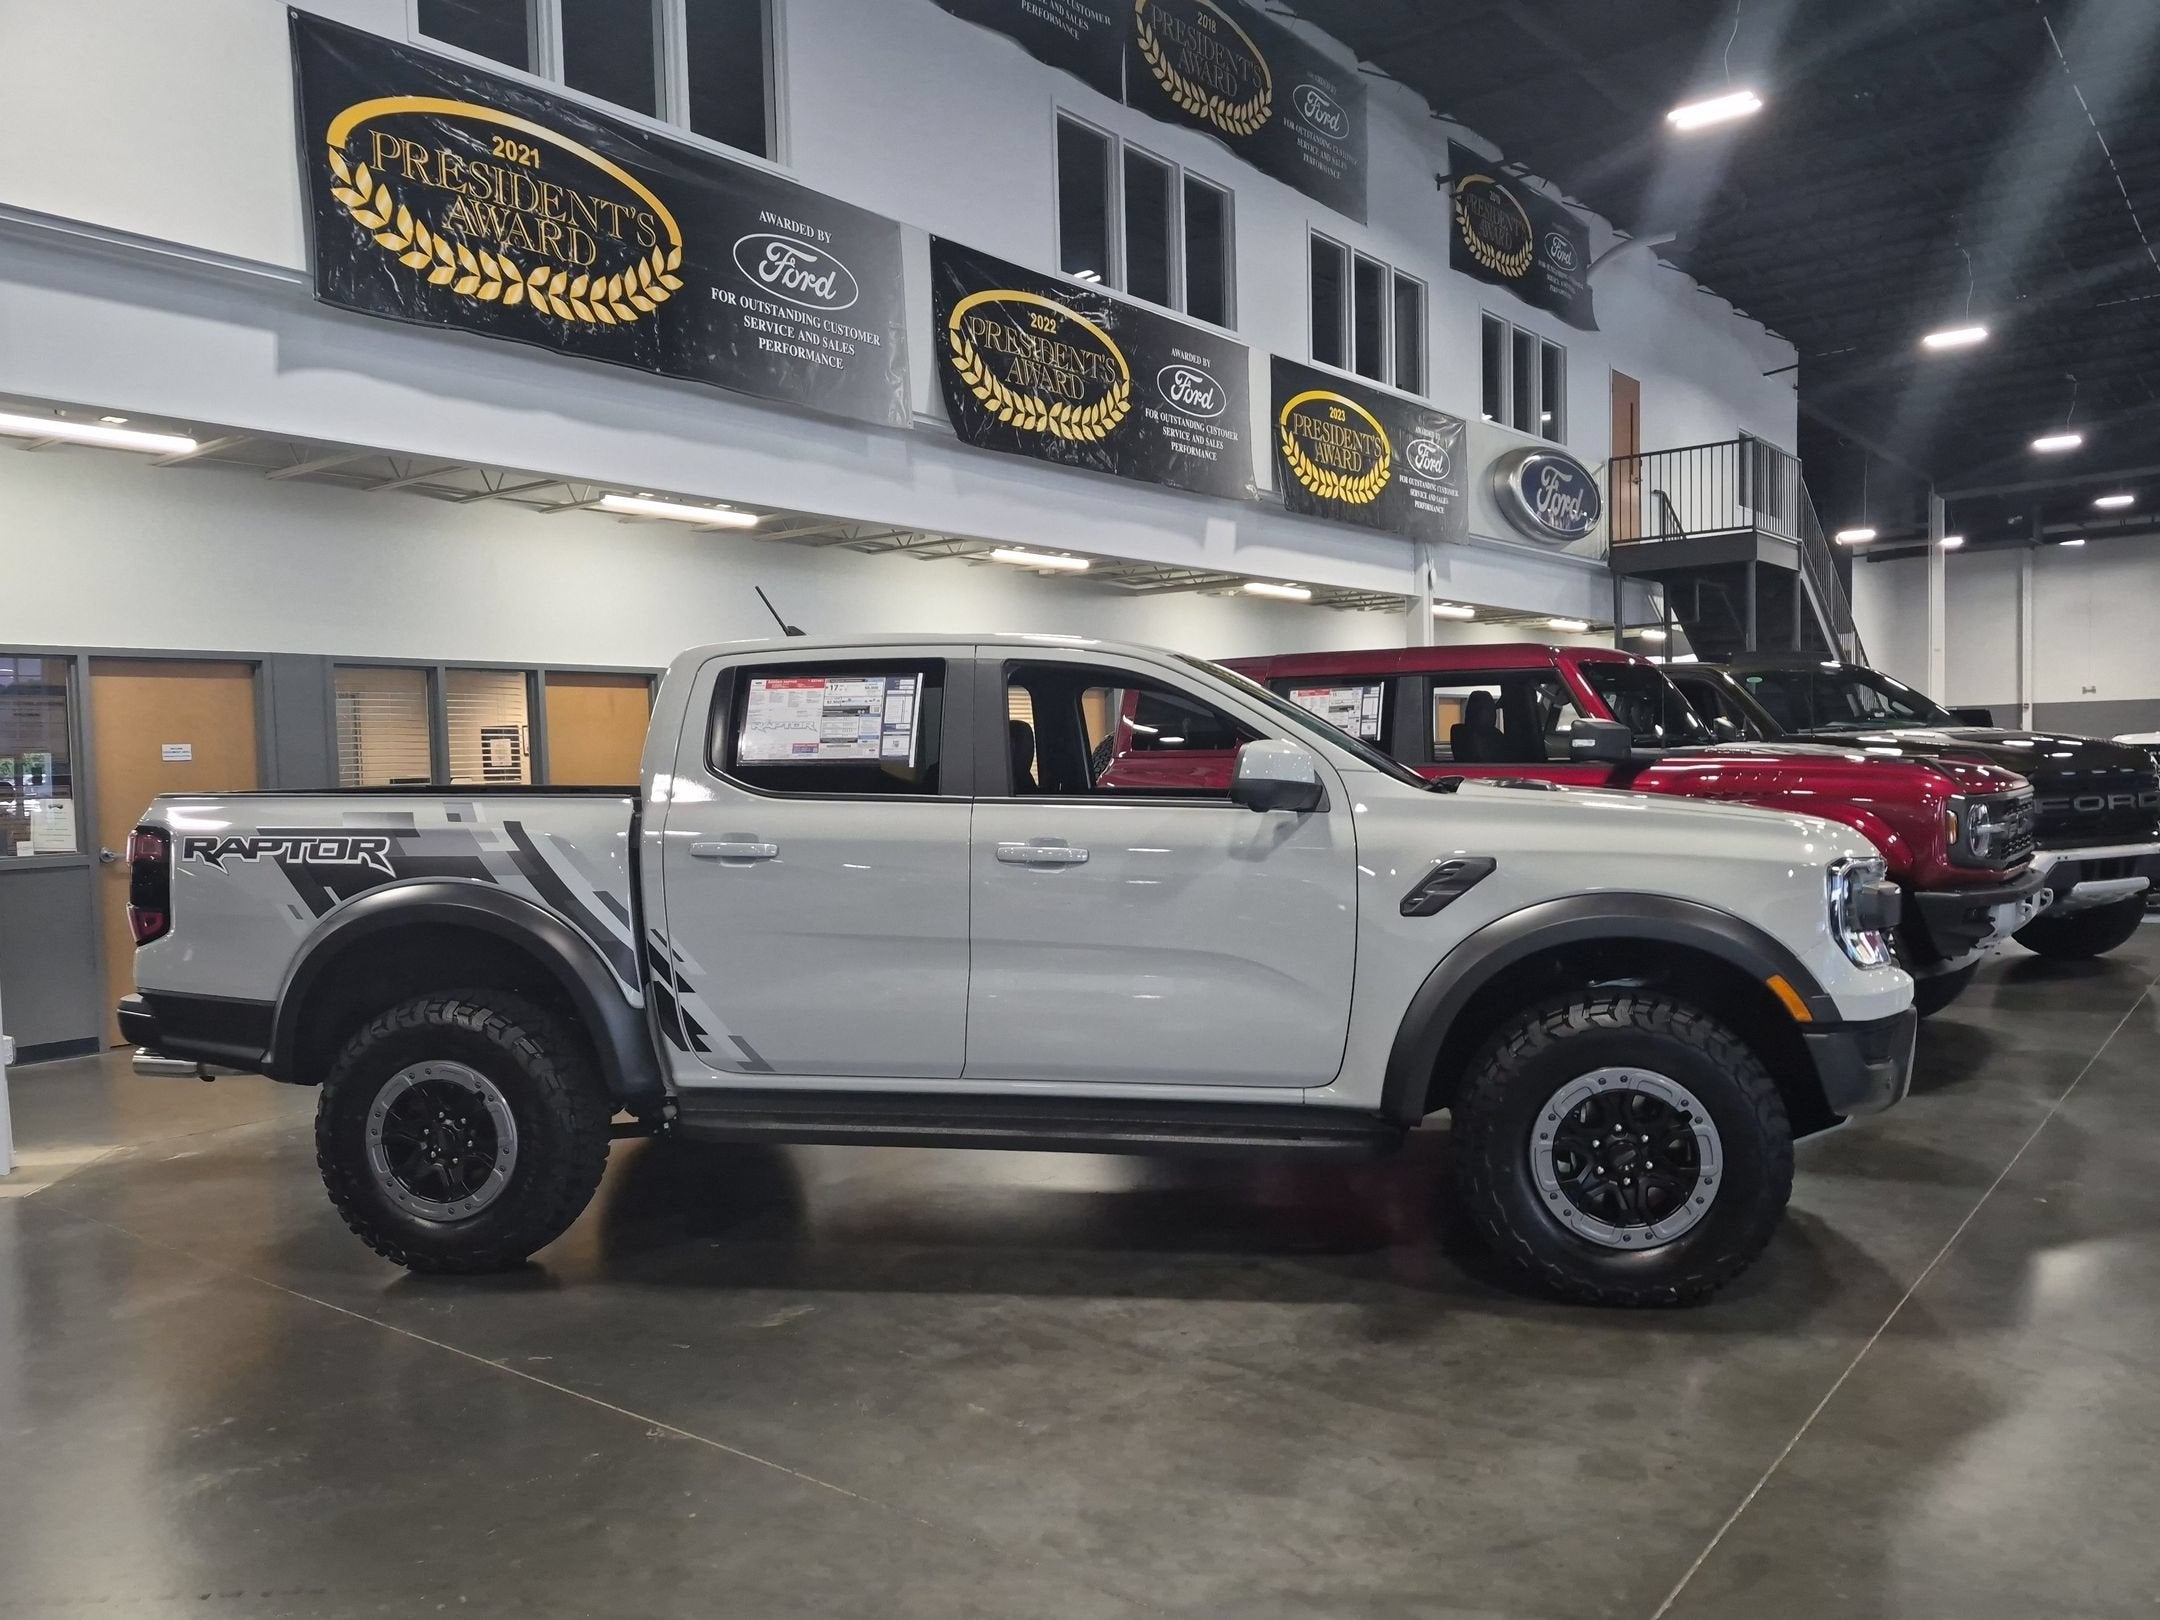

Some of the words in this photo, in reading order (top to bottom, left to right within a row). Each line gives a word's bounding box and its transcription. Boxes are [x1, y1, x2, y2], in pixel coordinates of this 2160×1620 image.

[1021, 0, 1079, 40] PERFORMANCE
[1066, 8, 1088, 30] SALES
[1198, 11, 1216, 33] 2018
[1151, 3, 1262, 88] PRESIDENT'S
[1179, 48, 1237, 96] AWARD
[1304, 91, 1340, 131] Ford
[492, 136, 541, 168] 2021
[369, 129, 656, 247] PRESIDENT'S
[442, 195, 597, 265] AWARD
[759, 210, 814, 238] AWARDED
[817, 229, 832, 244] BY
[759, 242, 836, 299] Ford
[1551, 236, 1572, 266] Ford
[711, 287, 737, 306] FOR
[740, 296, 821, 329] OUTSTANDING
[823, 320, 881, 346] CUSTOMER
[744, 315, 795, 339] SERVICE
[798, 330, 820, 346] AND
[822, 337, 855, 356] SALES
[1030, 313, 1057, 334] 2022
[759, 337, 844, 370] PERFORMANCE
[968, 316, 1116, 383] PRESIDENT'S
[1171, 348, 1201, 365] AWARDED
[1203, 357, 1211, 368] BY
[1005, 357, 1085, 400] AWARD
[1170, 370, 1214, 409] Ford
[1145, 407, 1159, 420] FOR
[1160, 411, 1205, 432] OUTSTANDING
[1206, 424, 1238, 441] CUSTOMER
[1329, 406, 1345, 421] 2023
[1163, 426, 1190, 441] SERVICE
[1192, 434, 1204, 445] AND
[1206, 437, 1224, 450] SALES
[1171, 441, 1217, 461] PERFORMANCE
[1293, 413, 1382, 457] PRESIDENT'S
[1315, 441, 1361, 473] AWARD
[1415, 443, 1443, 473] Ford
[1537, 465, 1584, 521] Ford
[182, 836, 397, 878] RAPTOR
